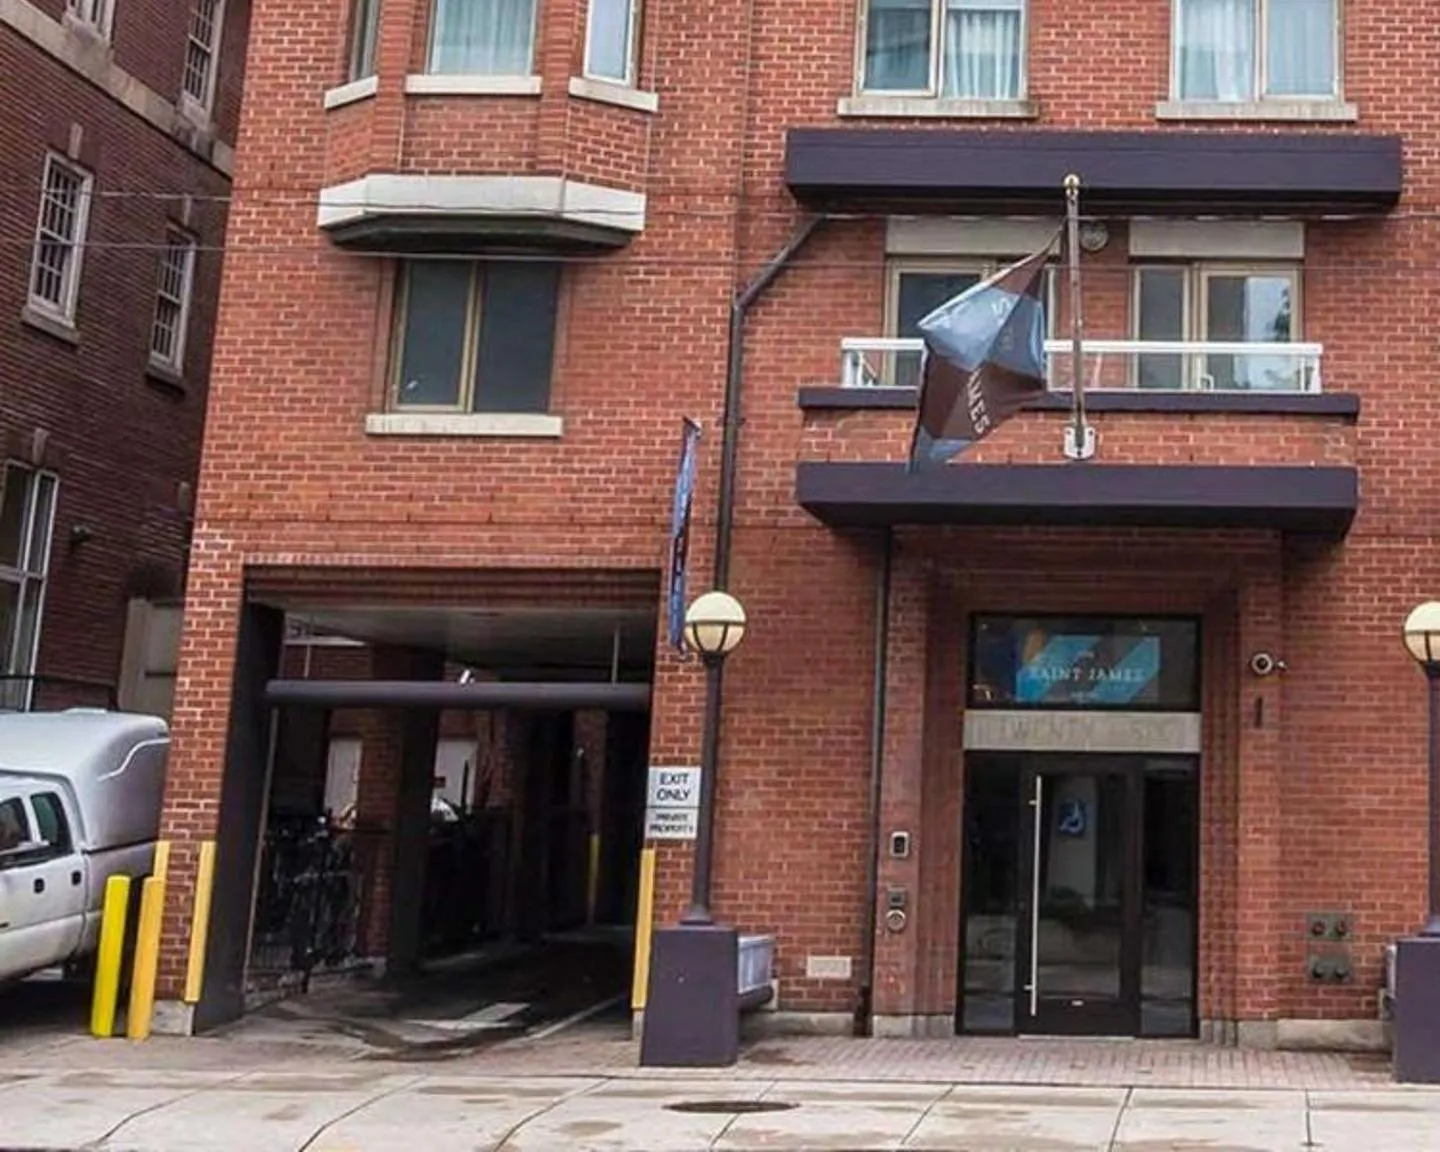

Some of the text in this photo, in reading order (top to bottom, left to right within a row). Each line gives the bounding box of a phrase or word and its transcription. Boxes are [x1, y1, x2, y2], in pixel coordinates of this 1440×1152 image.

[1087, 667, 1145, 682] JAMES
[659, 773, 689, 785] EXIT
[656, 788, 691, 801] ONLY
[656, 813, 689, 821] PRIVATE
[649, 824, 694, 833] PROPERTY
